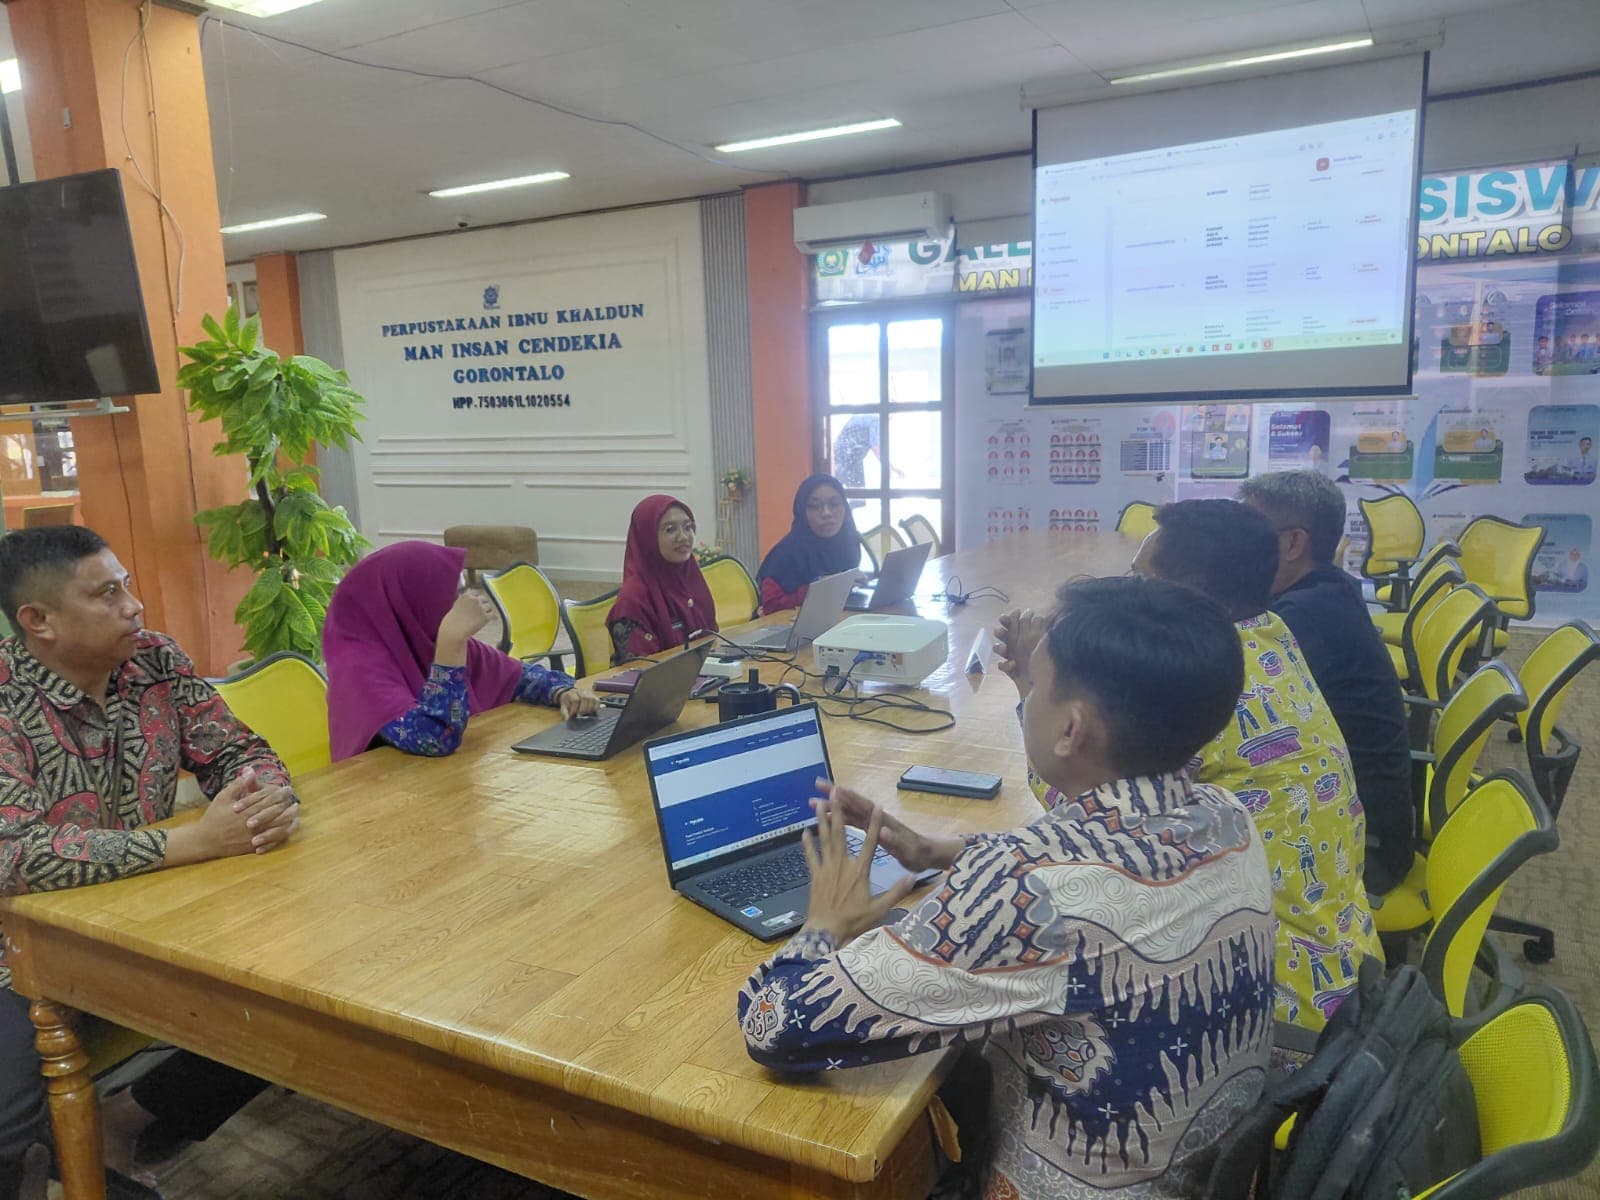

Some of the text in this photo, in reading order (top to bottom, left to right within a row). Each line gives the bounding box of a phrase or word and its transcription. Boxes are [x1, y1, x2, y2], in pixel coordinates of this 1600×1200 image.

[1419, 165, 1600, 221] SISW
[954, 267, 1020, 293] MAN
[382, 303, 645, 337] PERPUSTAKAAN IBNU KHALDUN
[404, 332, 622, 361] MAN INSAN CENDEKIA
[453, 364, 565, 384] GORONTALO
